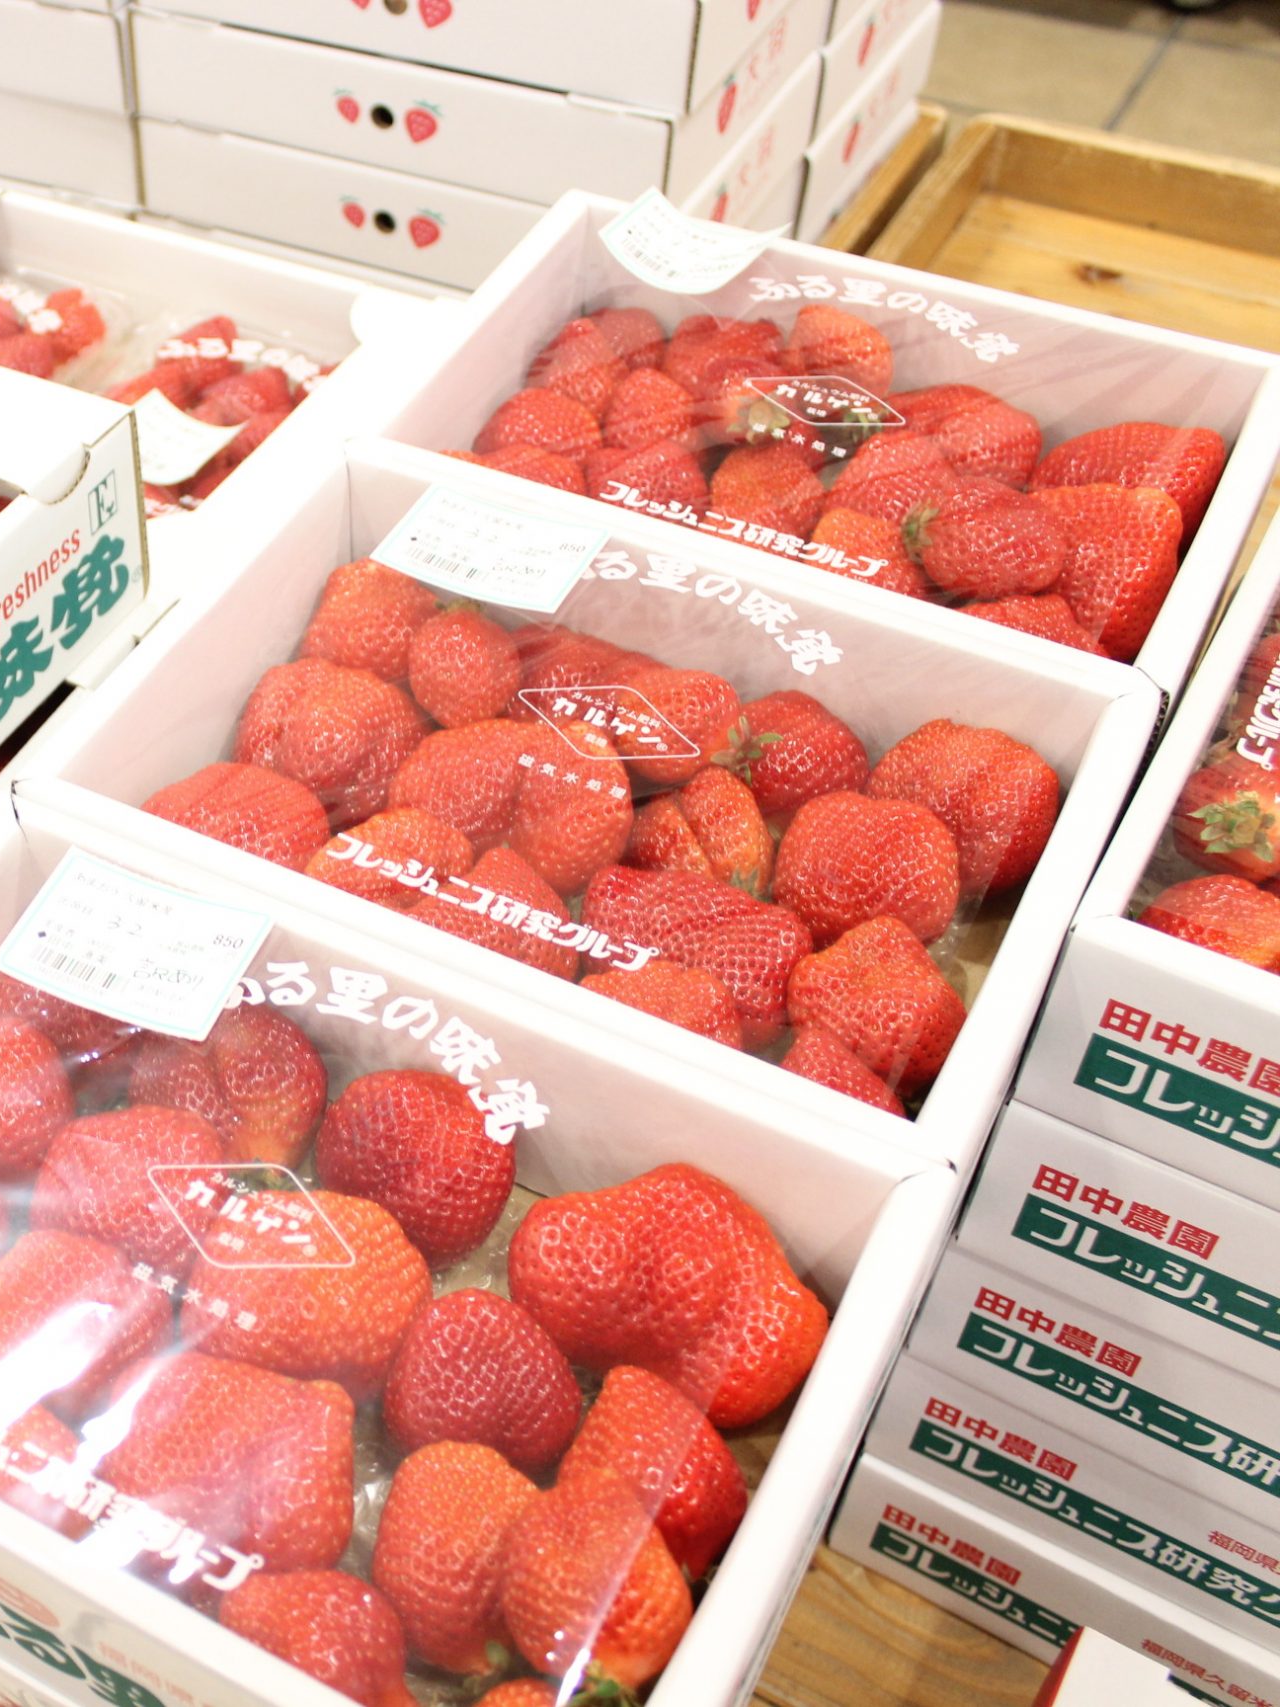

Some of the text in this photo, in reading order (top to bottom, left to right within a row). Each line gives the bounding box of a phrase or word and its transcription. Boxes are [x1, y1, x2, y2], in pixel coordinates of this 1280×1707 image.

[749, 273, 1022, 363] ふる里の味覚
[581, 550, 844, 676] る里の味覚
[325, 832, 663, 971] フレッシュニス研究グループ
[1099, 998, 1280, 1097] 田中農園
[1093, 1048, 1280, 1160] フレッシ
[1032, 1164, 1220, 1260] 田中農園
[1029, 1206, 1280, 1341] フレッシュニ
[974, 1286, 1143, 1377] 田中農園
[924, 1396, 1079, 1481] 田中農園
[882, 1504, 1022, 1587] 田中農園
[882, 1531, 1078, 1647] フレッシュニ
[1208, 1530, 1280, 1576] 福岡県
